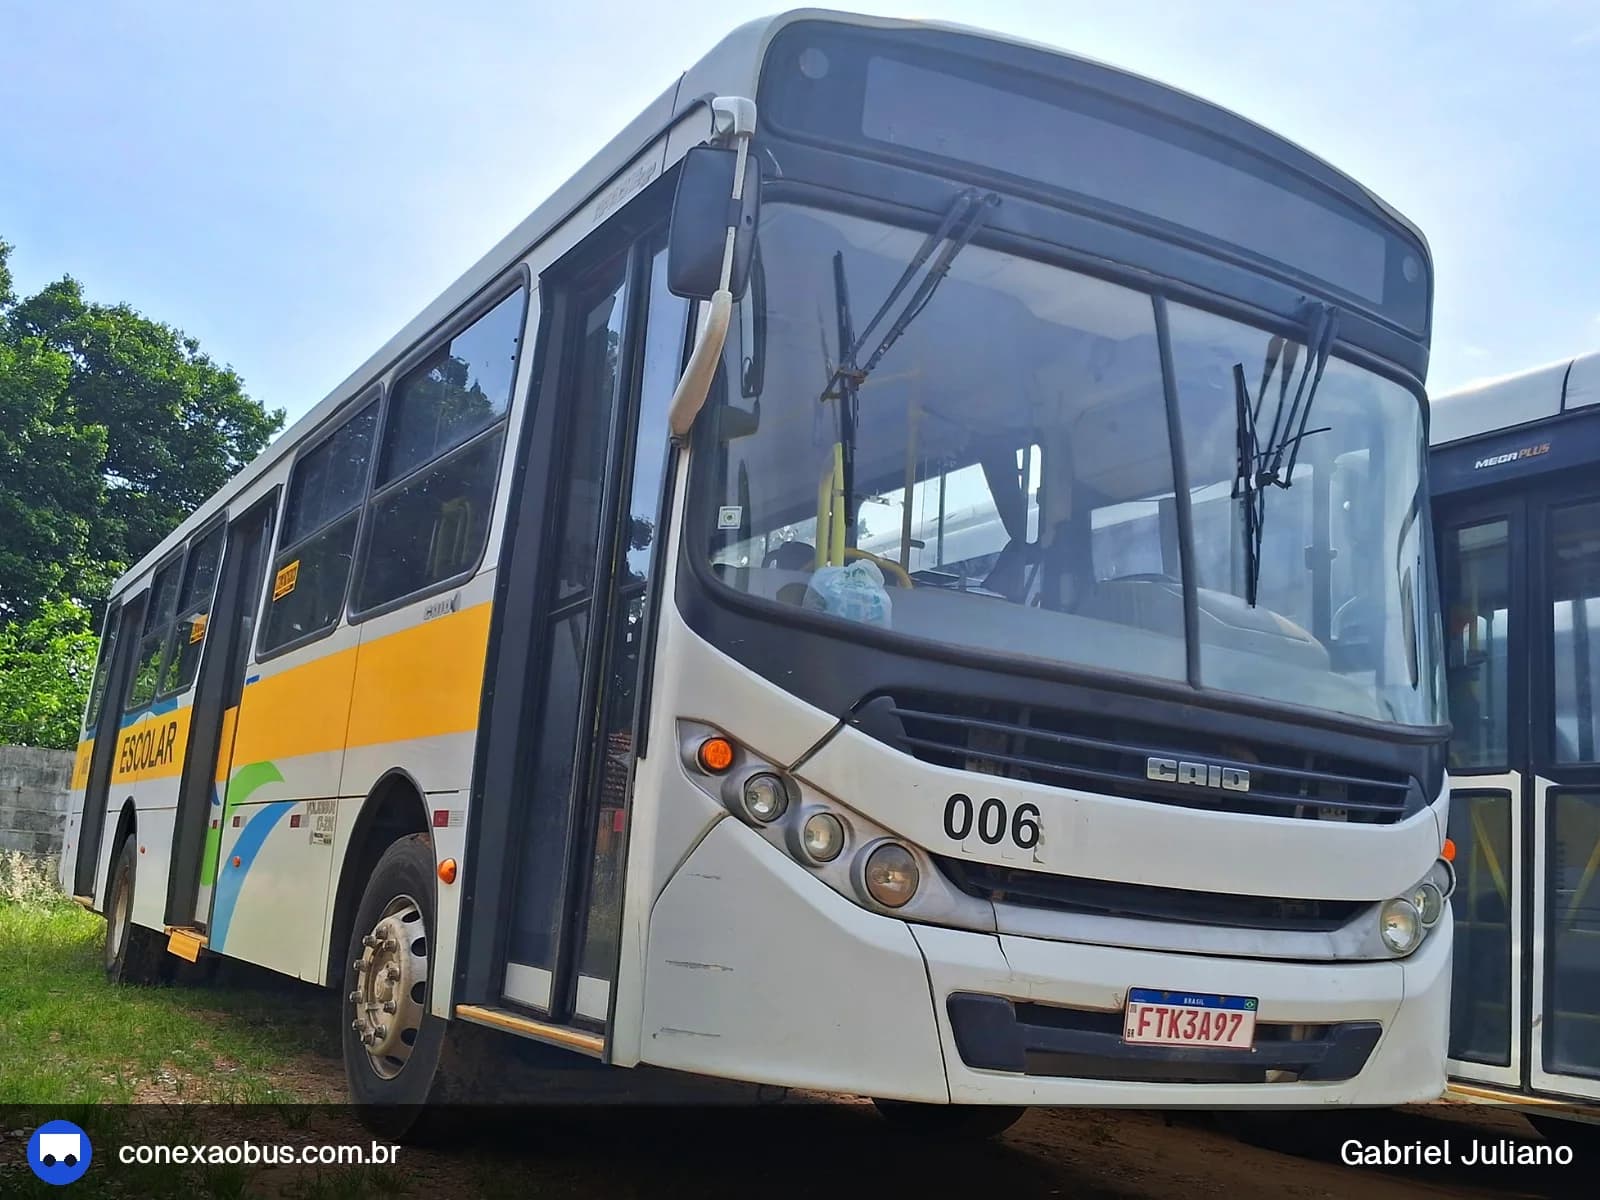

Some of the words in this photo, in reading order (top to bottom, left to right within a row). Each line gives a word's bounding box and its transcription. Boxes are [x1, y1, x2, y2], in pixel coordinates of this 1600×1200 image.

[1475, 452, 1518, 469] MEGA
[1518, 443, 1550, 458] PLUS
[120, 721, 177, 773] ESCOLAR
[1147, 757, 1249, 792] CAIO
[943, 793, 1041, 849] 006
[1183, 997, 1204, 1006] BRASIL
[1137, 1007, 1243, 1041] FTK3A97
